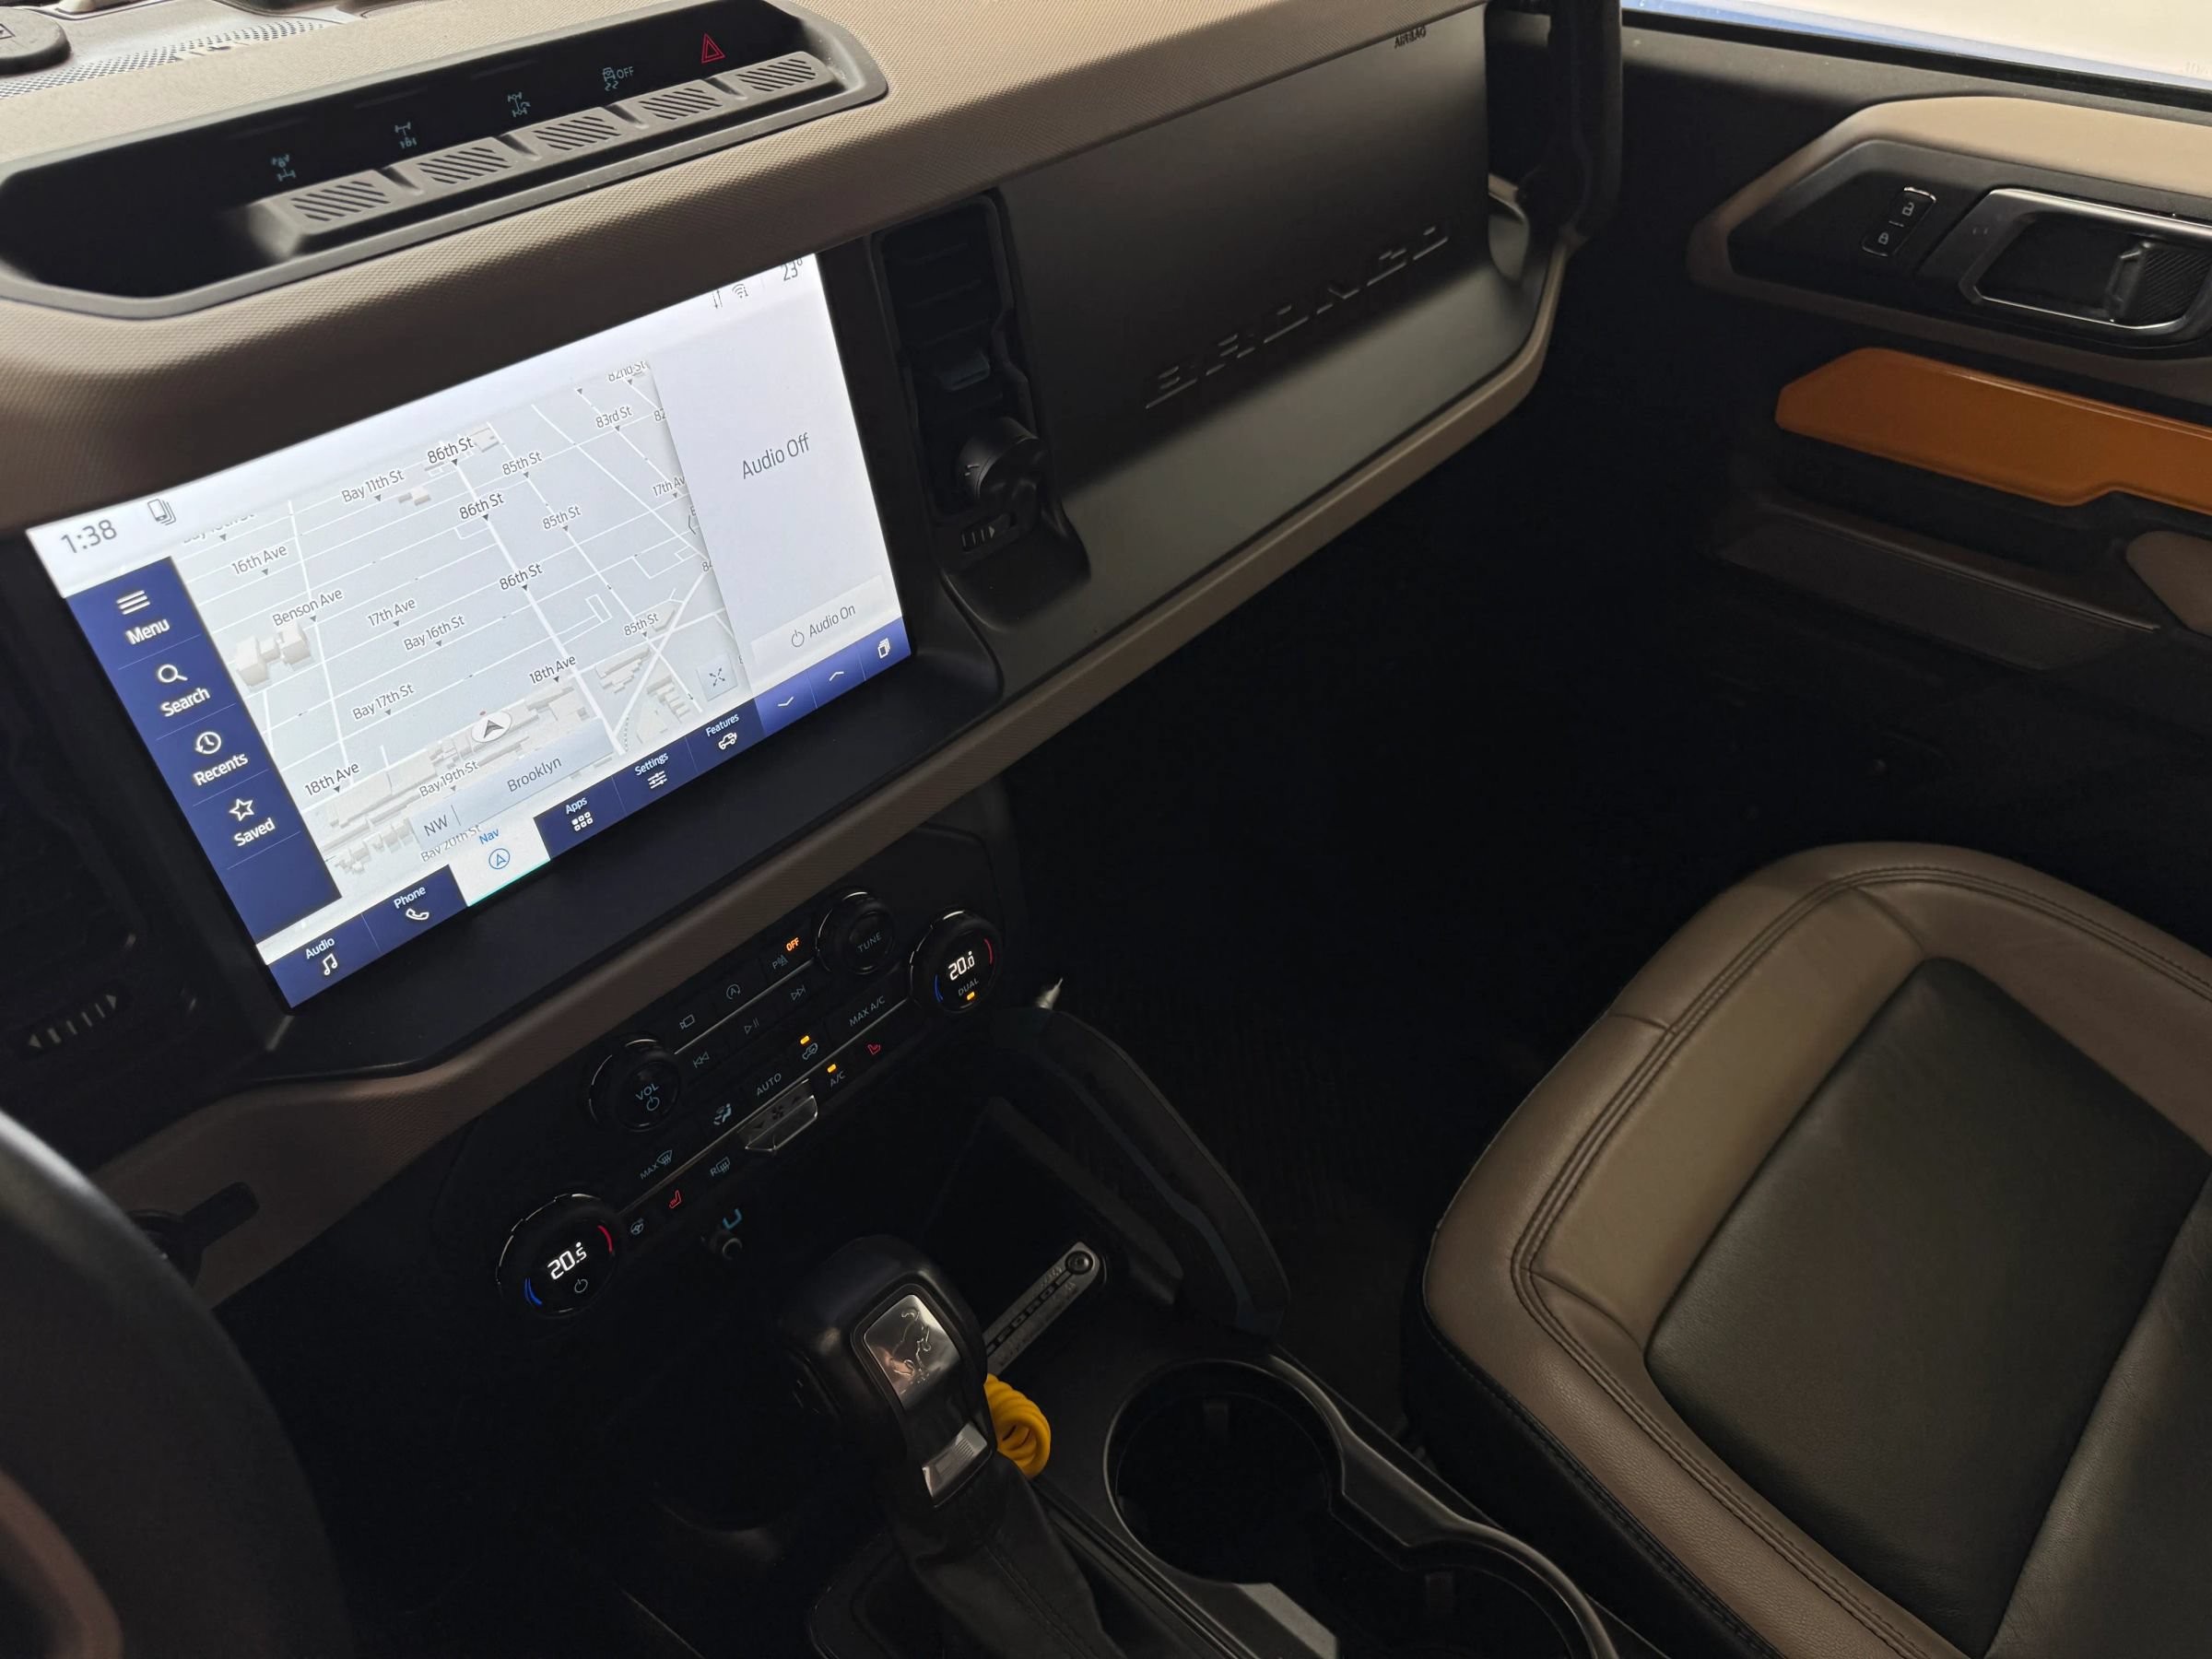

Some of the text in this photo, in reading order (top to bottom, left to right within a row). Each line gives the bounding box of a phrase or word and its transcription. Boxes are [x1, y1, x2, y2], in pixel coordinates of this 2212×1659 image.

[616, 65, 634, 79] OFF
[595, 406, 632, 429] 83rd St
[427, 436, 475, 465] 86th St
[501, 451, 542, 477] 85th St
[741, 431, 810, 479] Audio Off
[341, 468, 405, 503] Bay 11th St
[653, 480, 673, 497] 17th
[459, 492, 505, 521] 86th St
[542, 505, 582, 531] 85th St
[60, 519, 118, 553] 1:38
[231, 545, 288, 575] 16th Ave
[499, 563, 544, 591] 86th St
[272, 588, 343, 627] Benson Ave
[367, 598, 416, 628] 17th Ave
[808, 604, 856, 638] Audio On
[125, 618, 171, 645] Menu
[403, 615, 465, 651] Bay 16th St
[623, 612, 659, 636] 85th St
[528, 655, 576, 684] 18th Ave
[160, 687, 211, 717] Search
[352, 683, 415, 721] Bay 17th St
[705, 713, 740, 737] Features
[193, 753, 249, 786] Recents
[506, 757, 562, 793] Brooklyn
[634, 752, 669, 776] Settings
[305, 763, 360, 796] 18th Ave
[418, 759, 479, 797] Bay 19th St
[565, 796, 588, 815] Apps
[233, 818, 276, 847] Saved
[423, 816, 448, 837] NW
[478, 829, 500, 845] Nav
[393, 886, 427, 910] Phone
[304, 936, 335, 959] Audio
[785, 936, 800, 951] OFF
[857, 931, 883, 954] TUNE
[958, 977, 980, 996] DUAL
[848, 995, 887, 1027] MAX A/C
[756, 1072, 782, 1097] AUTO
[830, 1069, 846, 1088] A/C
[635, 1083, 660, 1102] VOL
[640, 1162, 659, 1181] MAX
